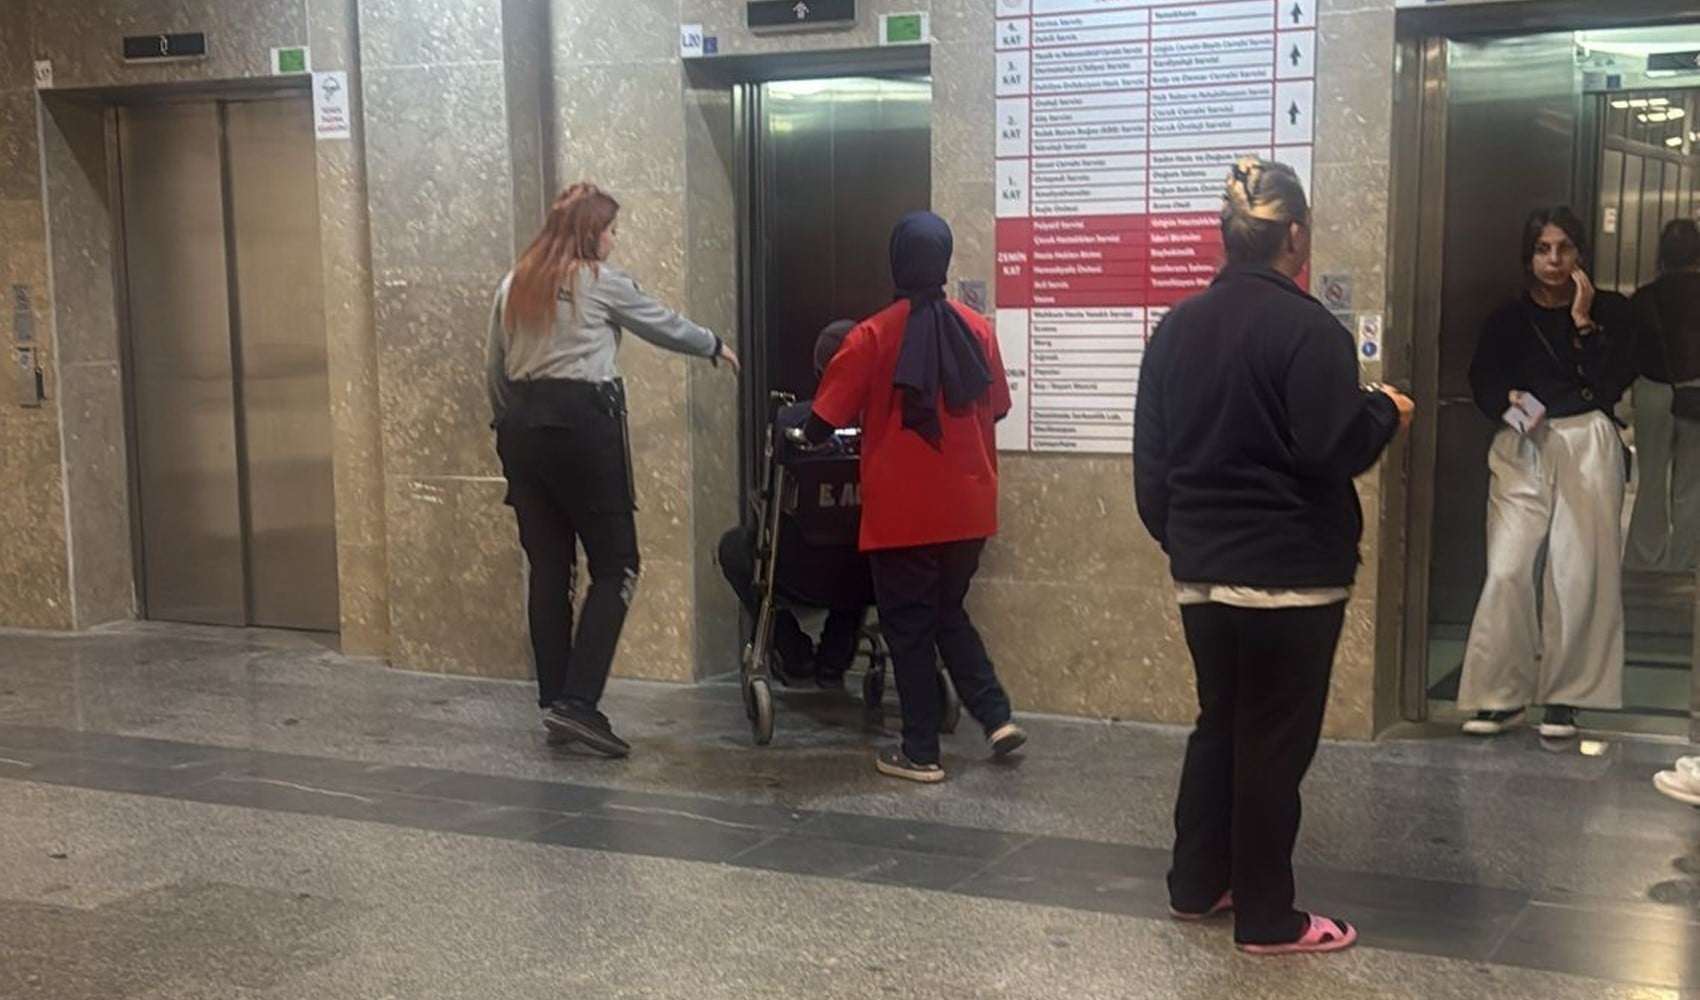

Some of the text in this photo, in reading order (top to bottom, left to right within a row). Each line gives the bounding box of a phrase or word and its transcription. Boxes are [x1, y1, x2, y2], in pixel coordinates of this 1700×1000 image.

[1003, 35, 1021, 45] KAT
[1003, 75, 1021, 85] KAT
[1003, 129, 1021, 139] KAT
[1003, 189, 1021, 199] KAT
[998, 252, 1028, 263] ZEMİN
[1003, 265, 1021, 276] KAT
